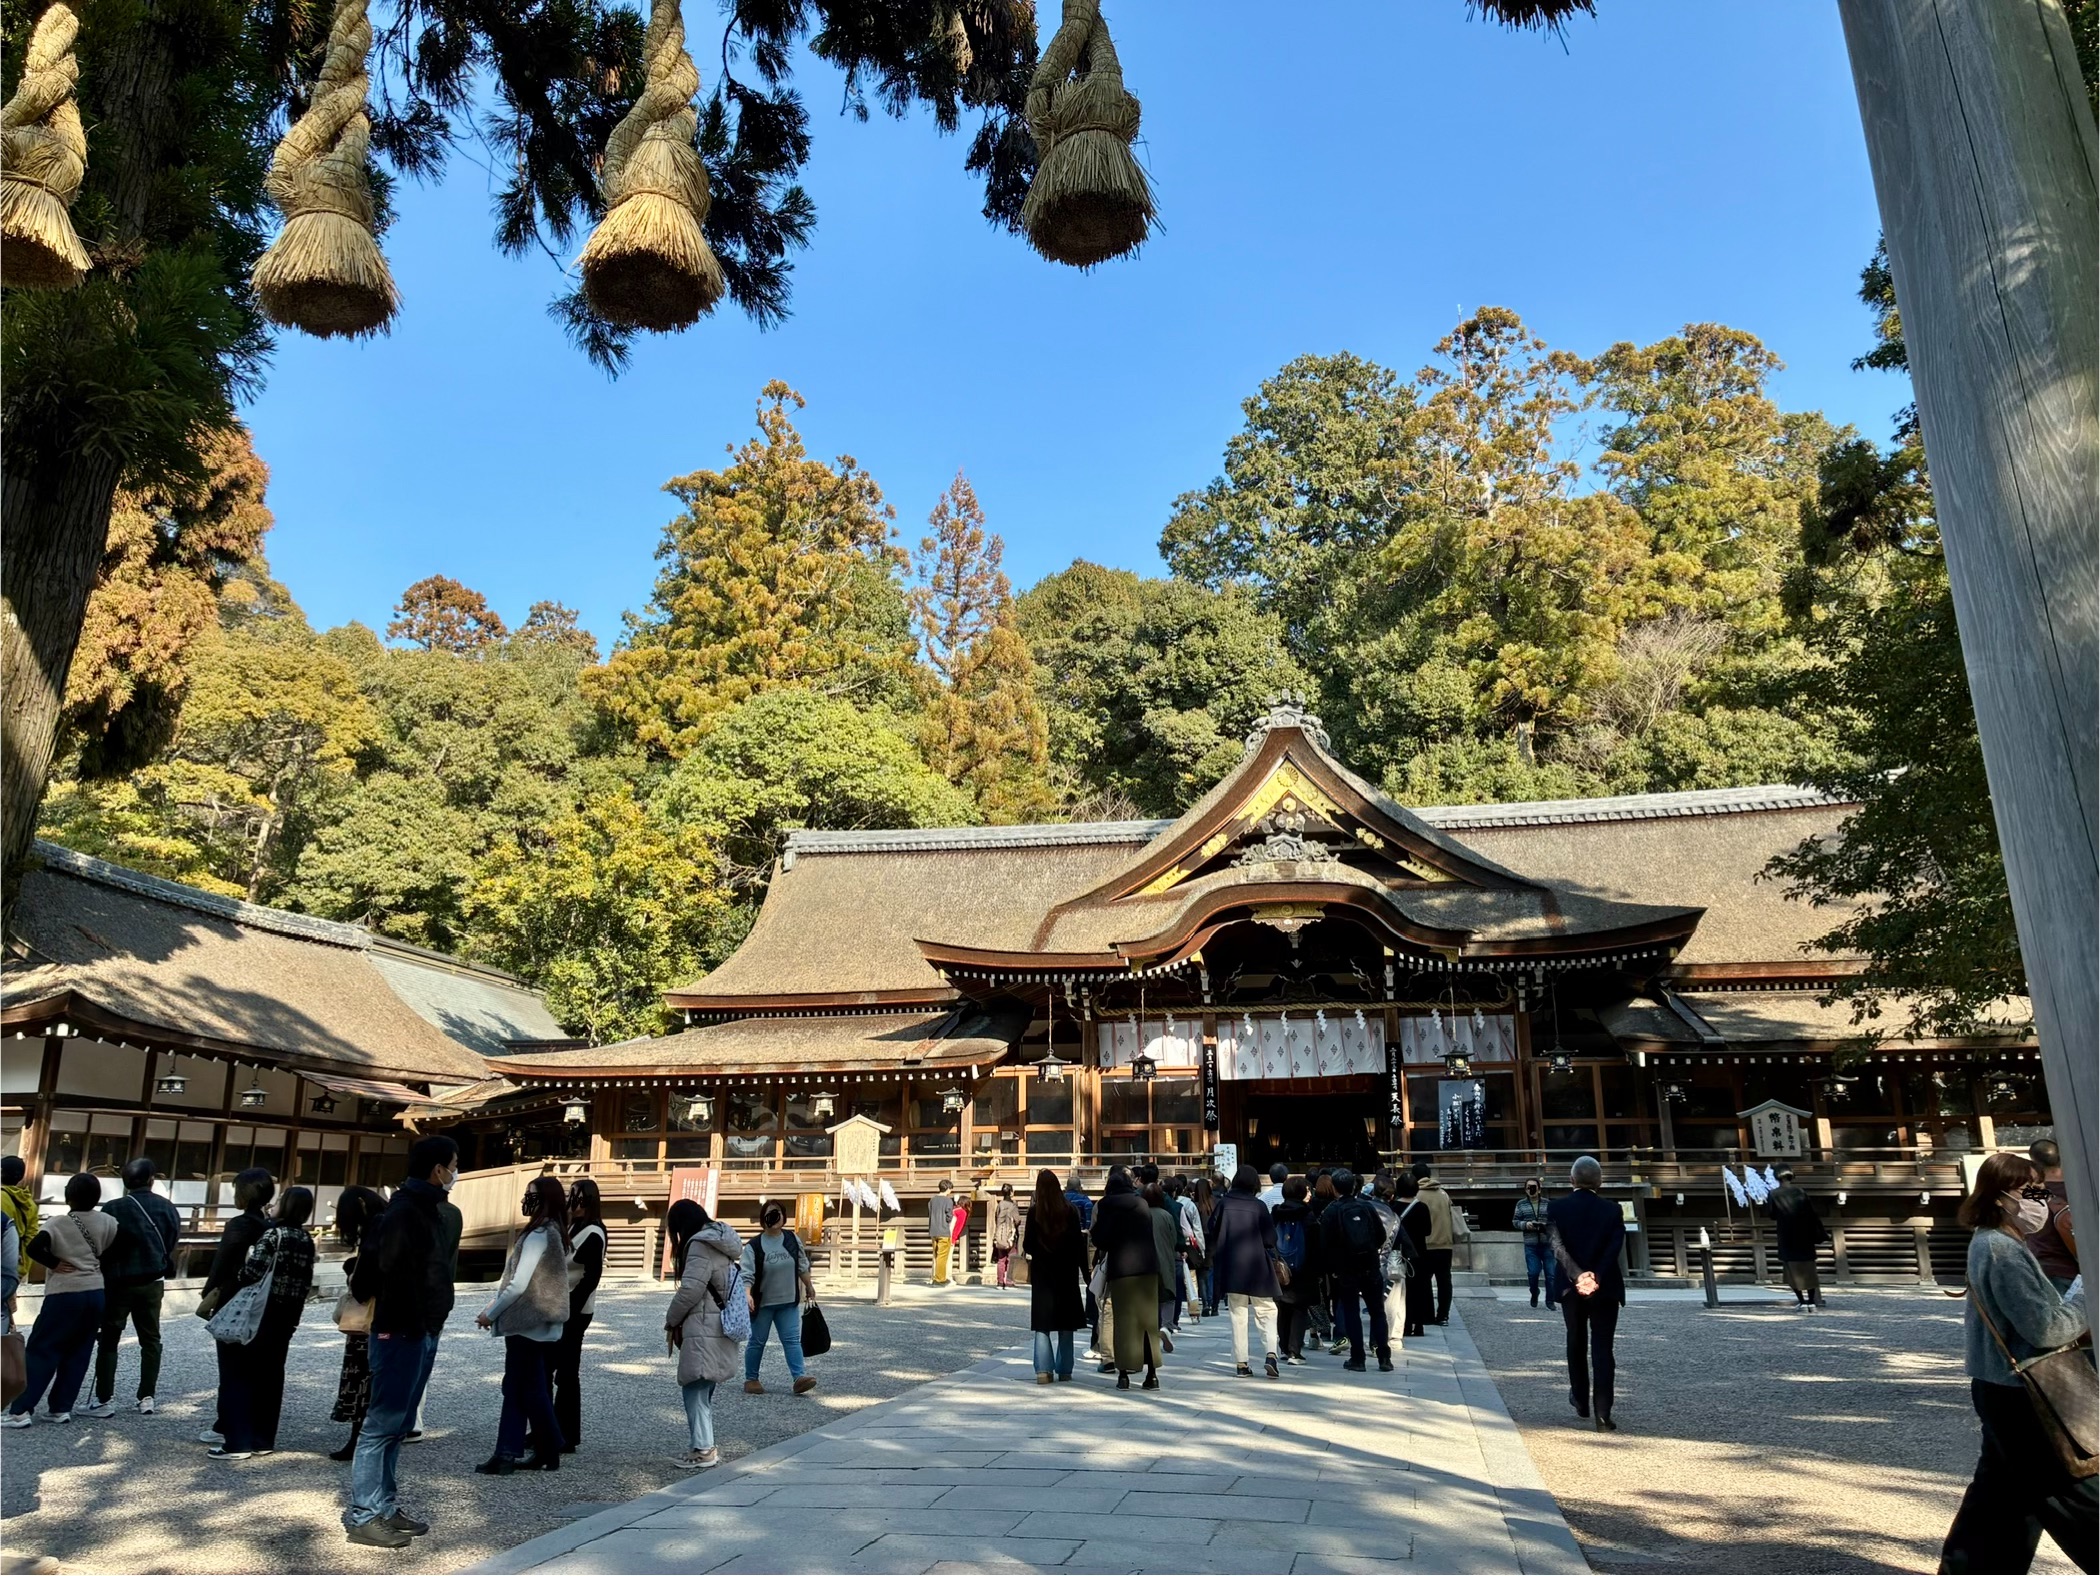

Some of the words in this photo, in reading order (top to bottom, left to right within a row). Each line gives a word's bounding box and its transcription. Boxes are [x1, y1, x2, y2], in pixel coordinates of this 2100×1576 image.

[1205, 1086, 1217, 1122] 月次祭
[1390, 1092, 1402, 1127] 天長祭
[1768, 1112, 1784, 1152] 幣帛料
